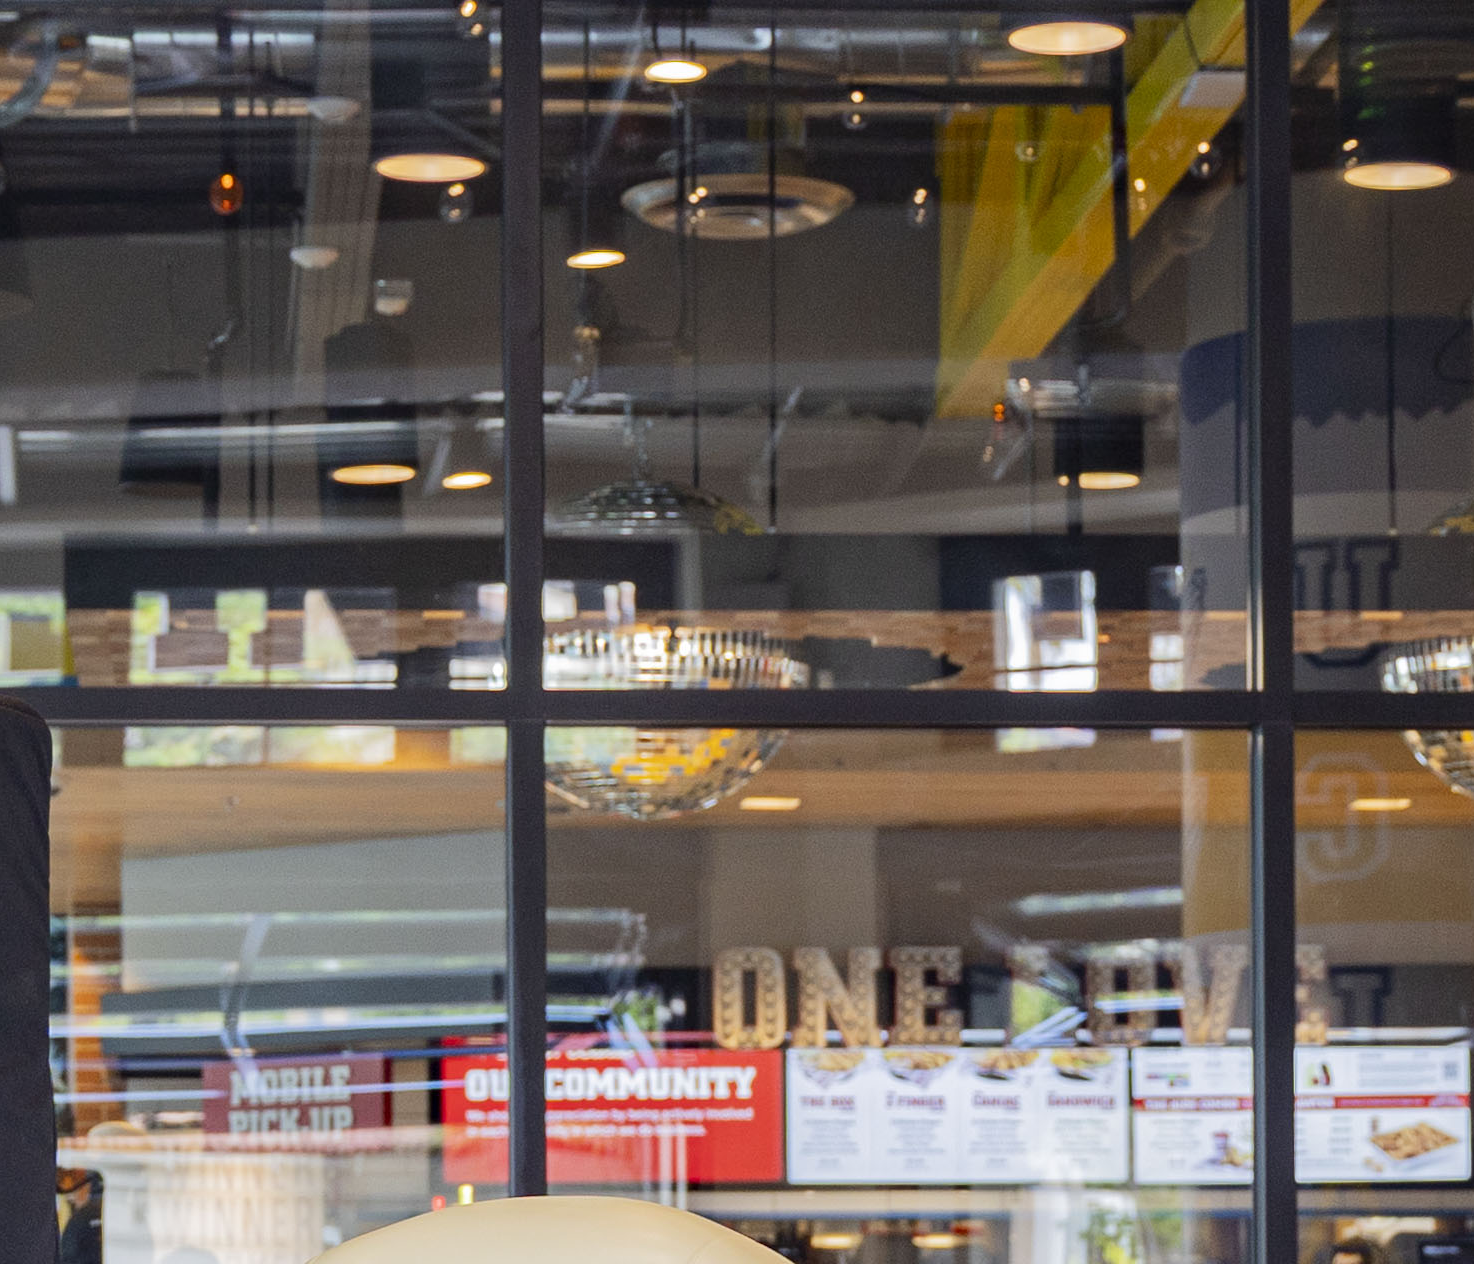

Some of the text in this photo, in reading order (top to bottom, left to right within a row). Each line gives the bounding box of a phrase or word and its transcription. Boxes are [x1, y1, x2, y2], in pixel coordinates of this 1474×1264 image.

[713, 946, 963, 1049] ONE
[230, 1065, 351, 1106] MOBILE
[465, 1066, 756, 1101] OU COMMUNITY
[228, 1105, 354, 1145] PICK-UP
